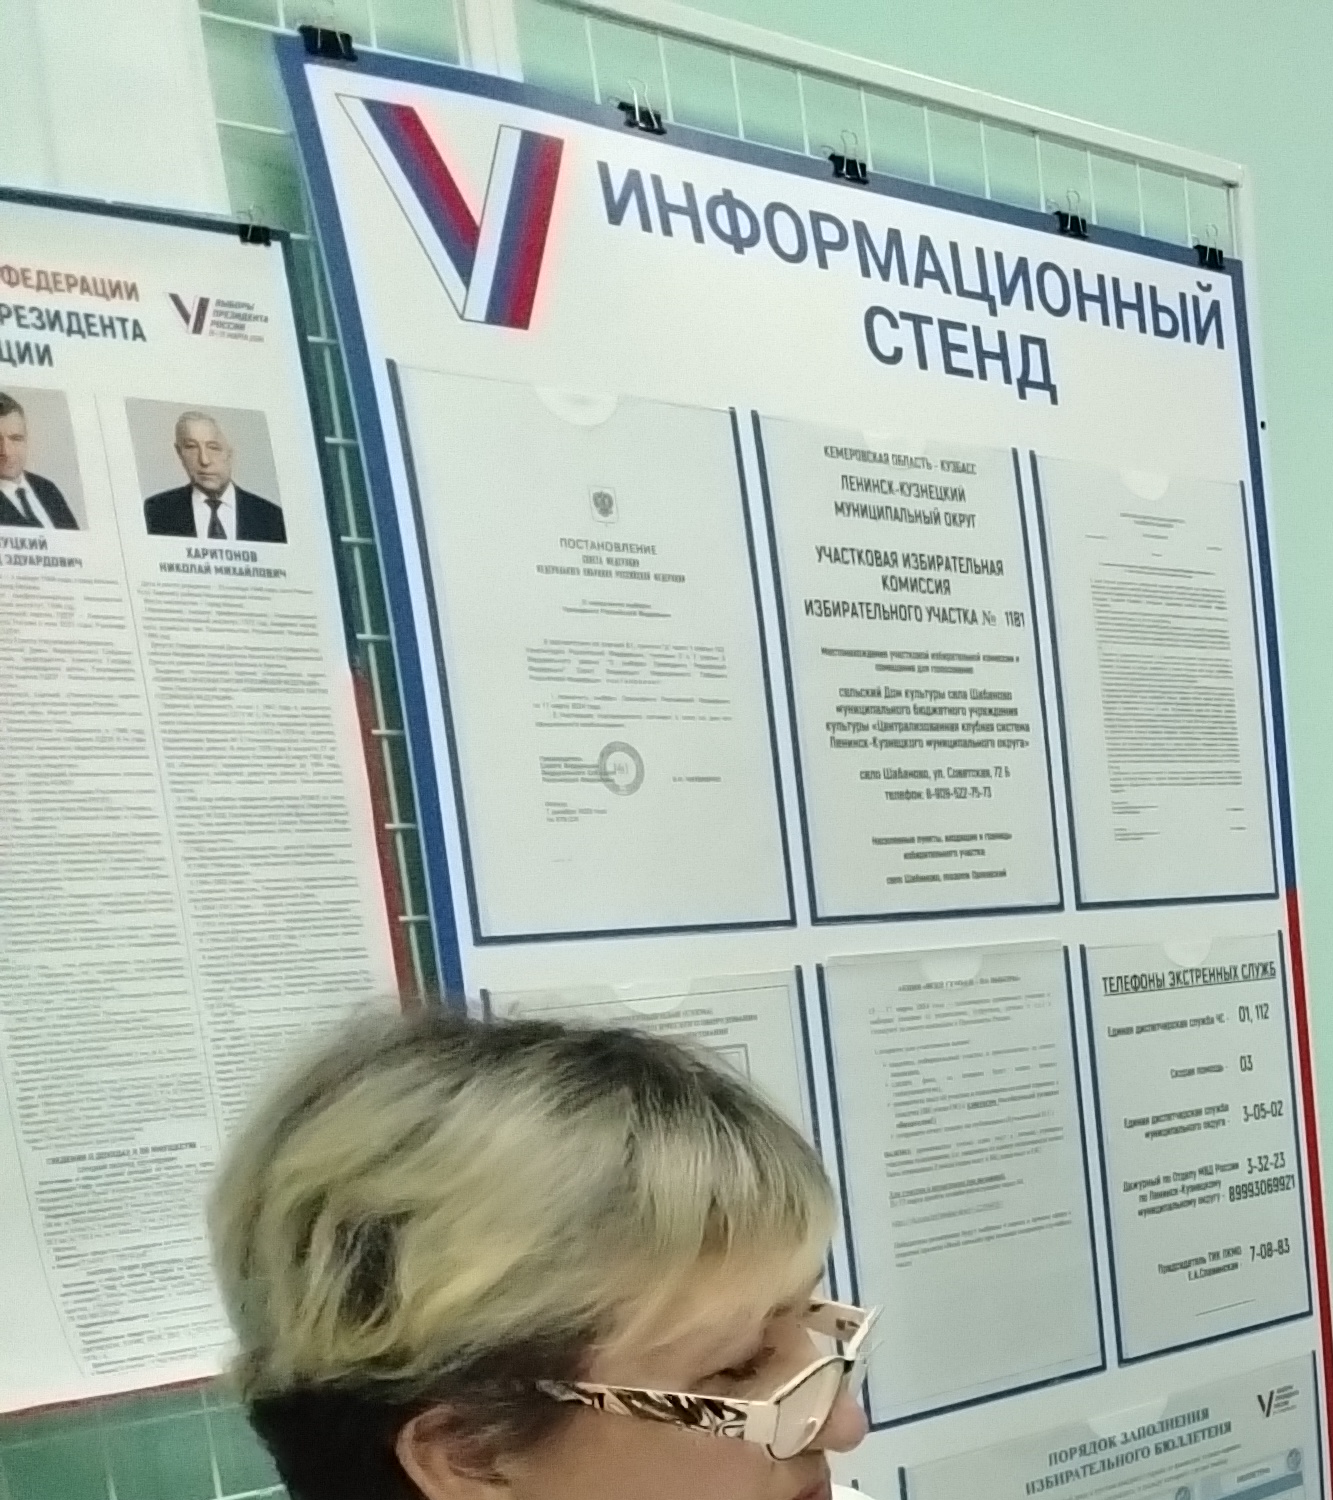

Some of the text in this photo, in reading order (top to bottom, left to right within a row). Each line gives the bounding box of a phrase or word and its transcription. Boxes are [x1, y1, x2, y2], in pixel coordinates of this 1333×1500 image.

[597, 160, 1225, 351] ИНФОРМАЦИОННЫЙ
[0, 265, 140, 302] ФЕДЕРАЦИИ
[0, 303, 147, 342] РЕЗИДЕНТА
[864, 305, 1059, 406] СТЕНД
[823, 446, 889, 464] КЕМЕРОВСКАЯ
[892, 453, 932, 470] ОБЛАСТЬ
[940, 460, 977, 475] КУЗБАСС
[841, 475, 967, 502] ЛЕНИНСК-КУЗНЕЦКИЙ
[834, 501, 976, 528] МУНИЦИПАЛЬНЫЙ ОКРУГ
[0, 535, 48, 550] УЦКИЙ
[560, 537, 658, 555] ПОСТАНОВЛЕНИЕ
[187, 547, 258, 563] ХАРИТОНОВ
[815, 545, 1004, 576] УЧАСТКОВАЯ ИЗБИРАТЕЛЬНАЯ
[159, 562, 287, 579] НИКОЛАЙ МИХАЙЛОВИЧ
[881, 575, 952, 596] КОМИССИЯ
[804, 599, 1026, 628] ИЗБИРАТЕЛЬНОГО УЧАСТКА № 1181
[839, 686, 882, 699] сельский
[905, 689, 946, 702] культуры
[836, 703, 1018, 718] муниципального бюджетного учреждения
[826, 722, 869, 734] культуры
[961, 721, 995, 734] клубная
[996, 723, 1030, 732] система
[926, 738, 995, 750] муниципального
[860, 770, 881, 780] село
[1102, 961, 1277, 993] ТЕЛЕФОНЫ ЭКСТРЕННЫХ СЛУЖБ
[1238, 1005, 1253, 1024] 01,
[1255, 1003, 1270, 1020] 112
[1240, 1055, 1253, 1072] 03
[1243, 1100, 1284, 1122] 3-05-02
[1247, 1152, 1286, 1174] 3-32-23
[1228, 1174, 1296, 1202] 89993069921
[1250, 1238, 1290, 1262] 7-08-83
[1048, 1407, 1210, 1467] ПОРЯДОК ЗАПОЛНЕНИЯ
[1025, 1446, 1150, 1496] ИЗБИРАТЕЛЬНОГО
[1152, 1420, 1232, 1456] БЮЛЛЕТЕНЯ
